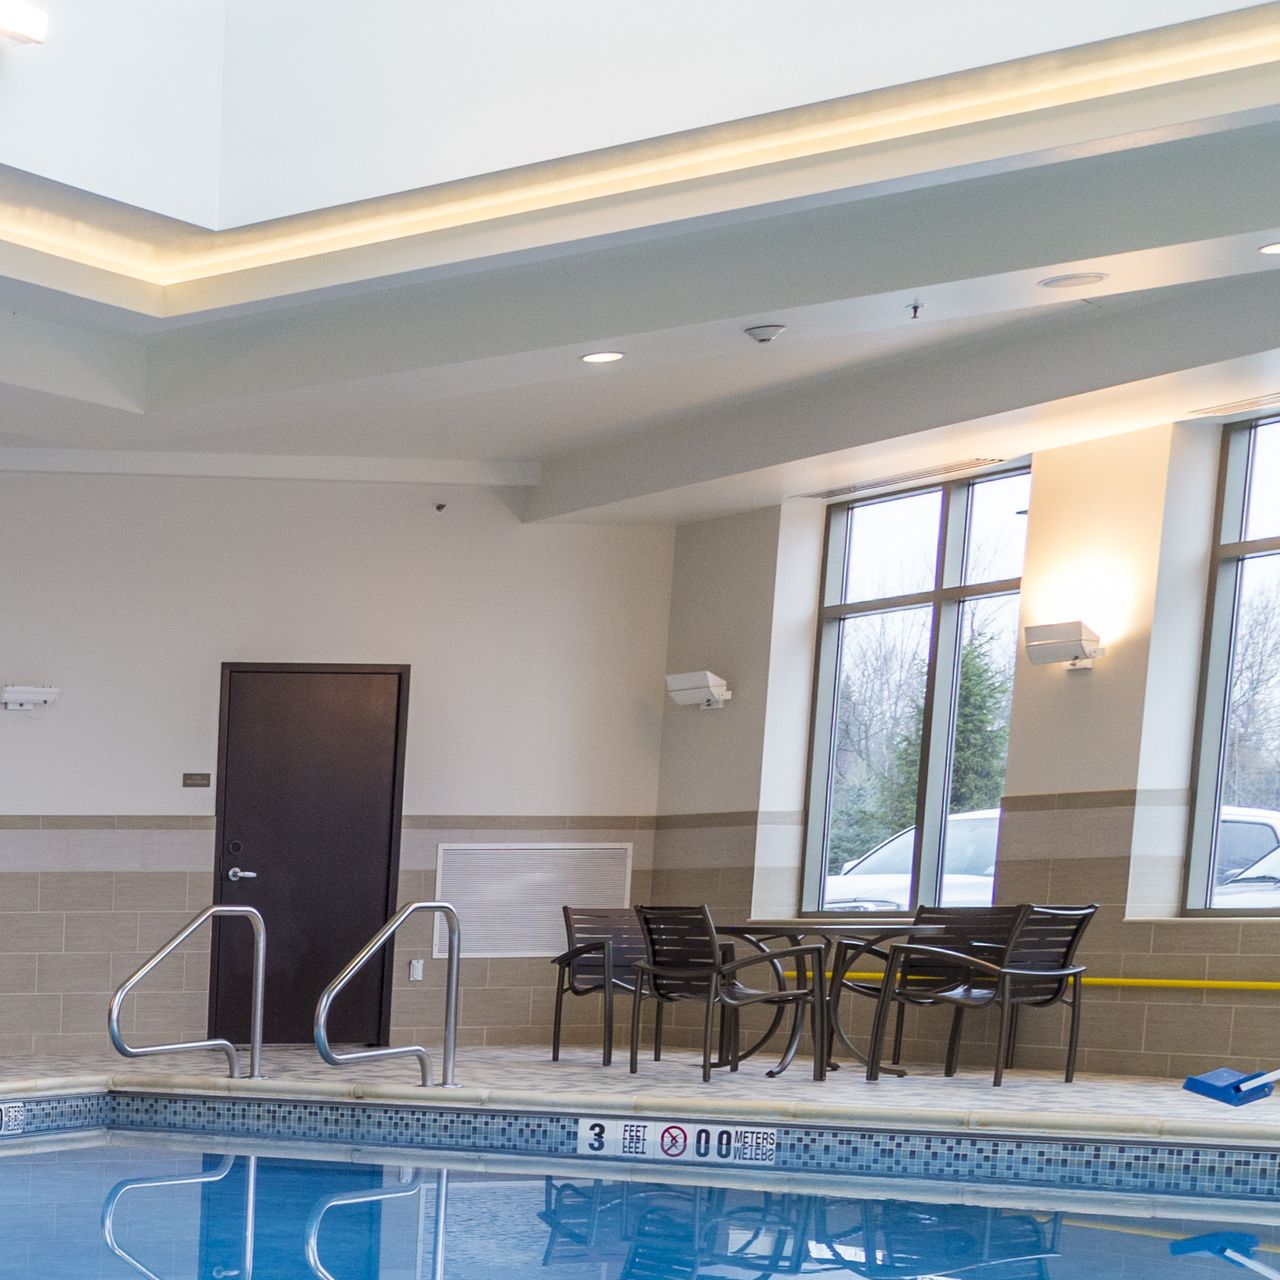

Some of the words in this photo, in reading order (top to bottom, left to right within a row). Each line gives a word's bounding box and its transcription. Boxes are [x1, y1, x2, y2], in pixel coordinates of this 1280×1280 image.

[588, 1123, 606, 1152] 3
[623, 1124, 648, 1138] FEET
[734, 1130, 775, 1146] METERS
